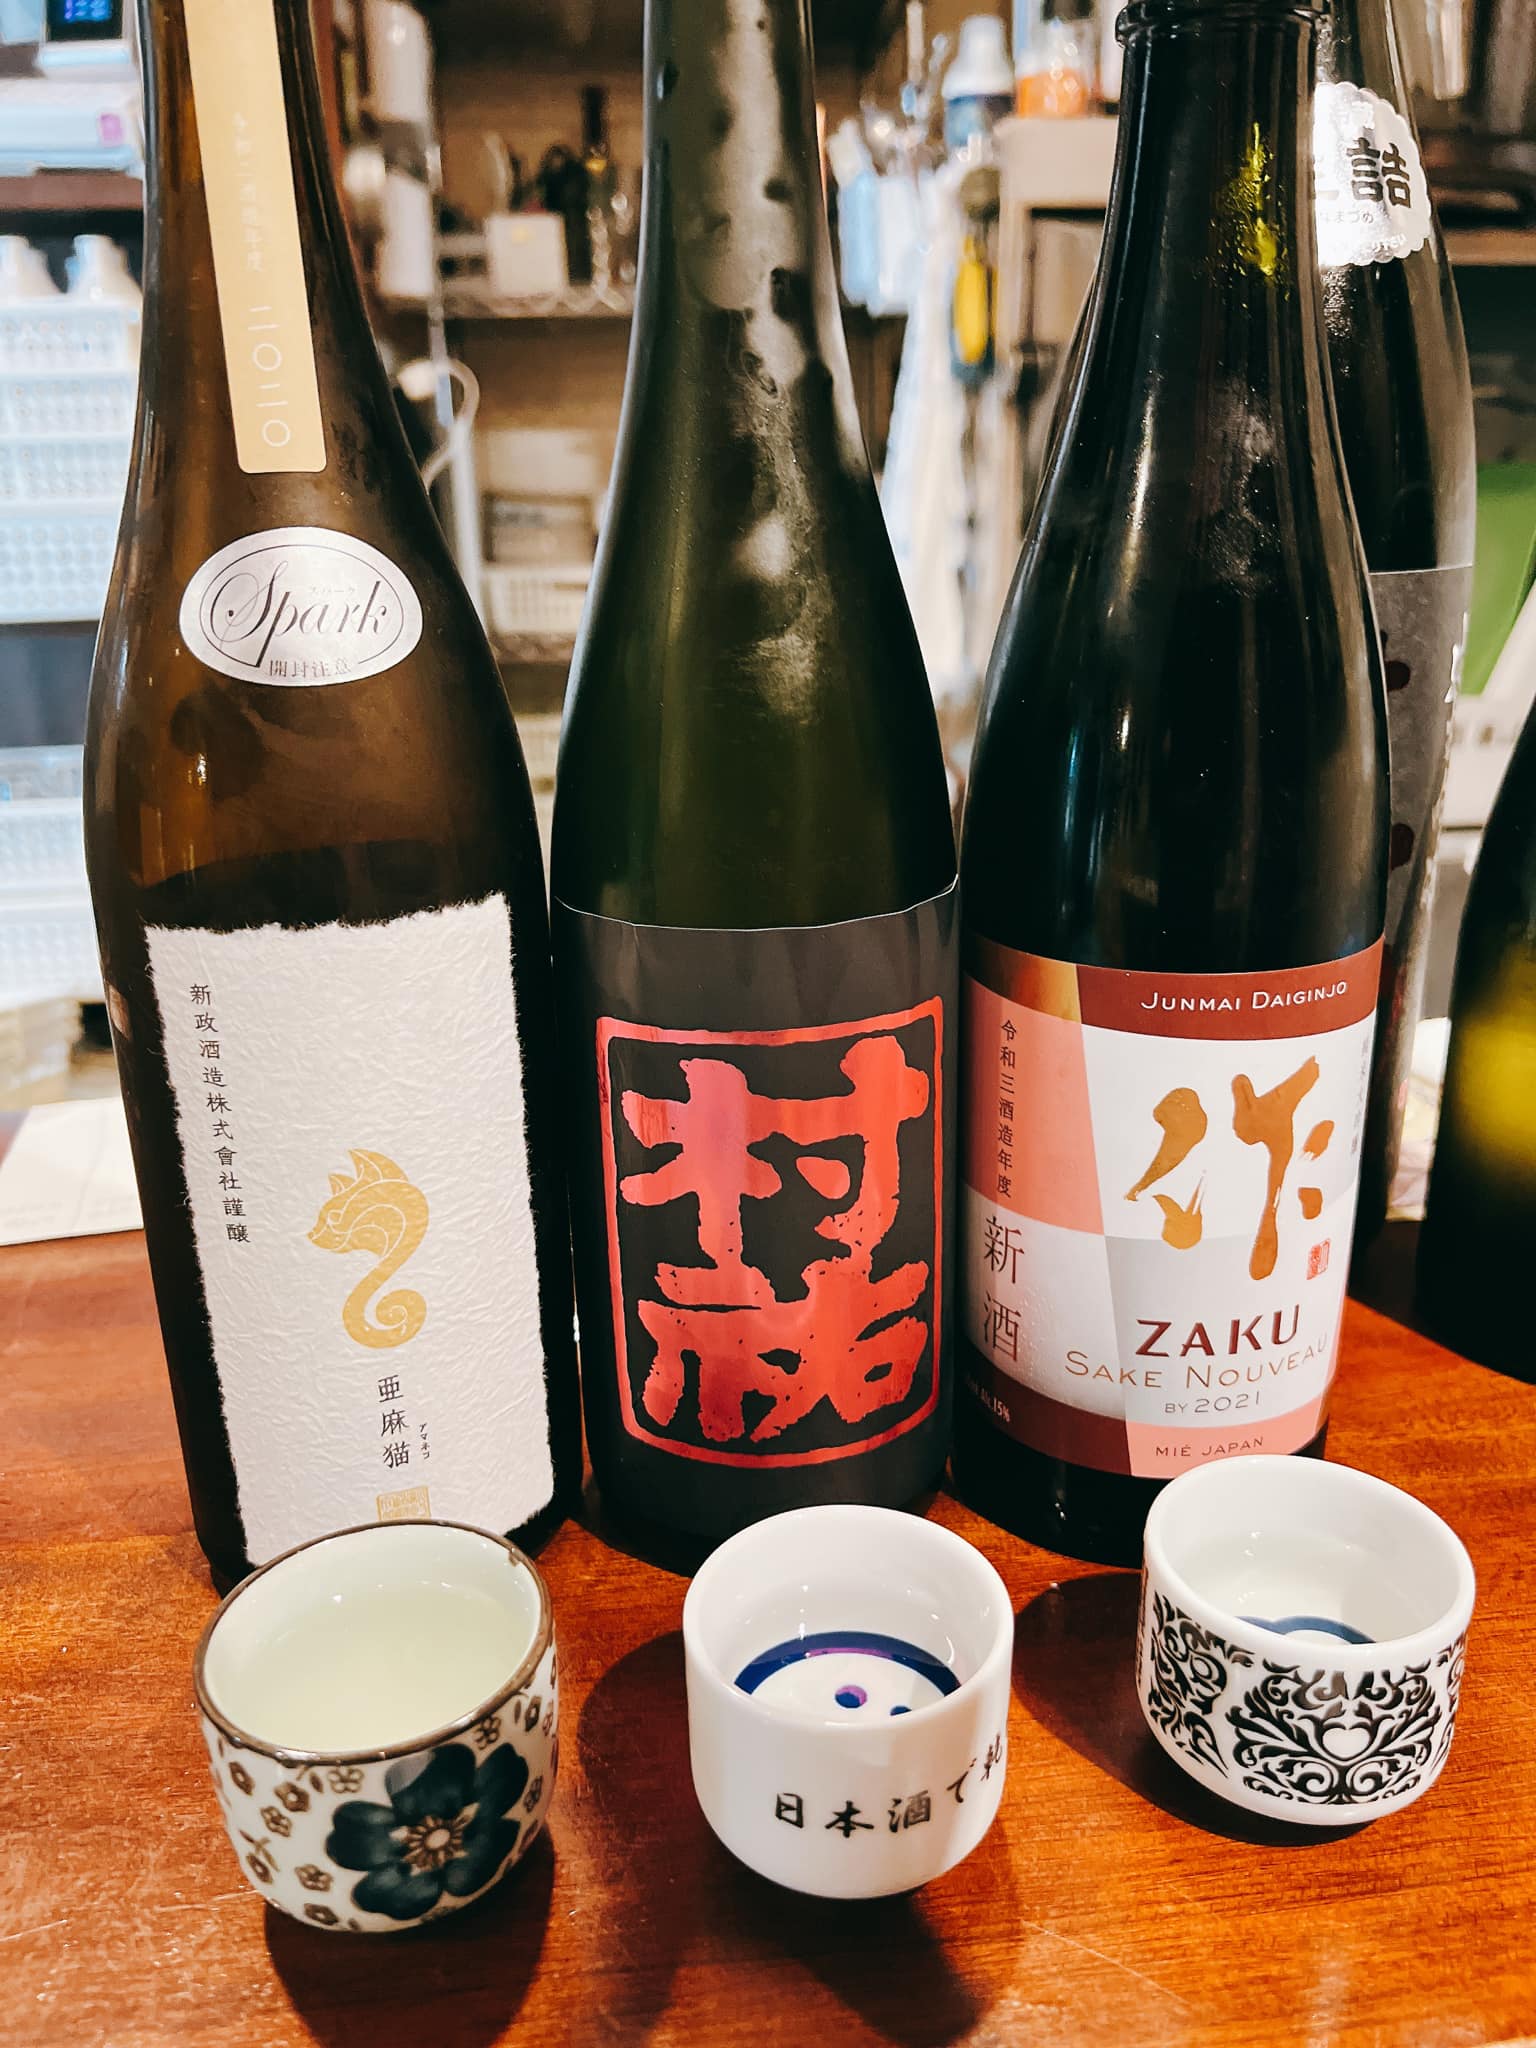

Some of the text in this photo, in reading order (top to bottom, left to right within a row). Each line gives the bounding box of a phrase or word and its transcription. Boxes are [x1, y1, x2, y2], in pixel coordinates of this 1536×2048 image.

[210, 560, 388, 668] Spark
[268, 657, 352, 679] 開封注意
[997, 1018, 1018, 1199] 令和三酒造年度
[1124, 1055, 1336, 1281] 作
[620, 1035, 931, 1443] 村祐
[983, 1214, 1025, 1363] 新酒
[1134, 1303, 1301, 1358] ZAKU
[377, 1374, 411, 1470] 亜麻猫
[1164, 1391, 1261, 1415] BY 2021
[1200, 1435, 1265, 1457] JAPAN
